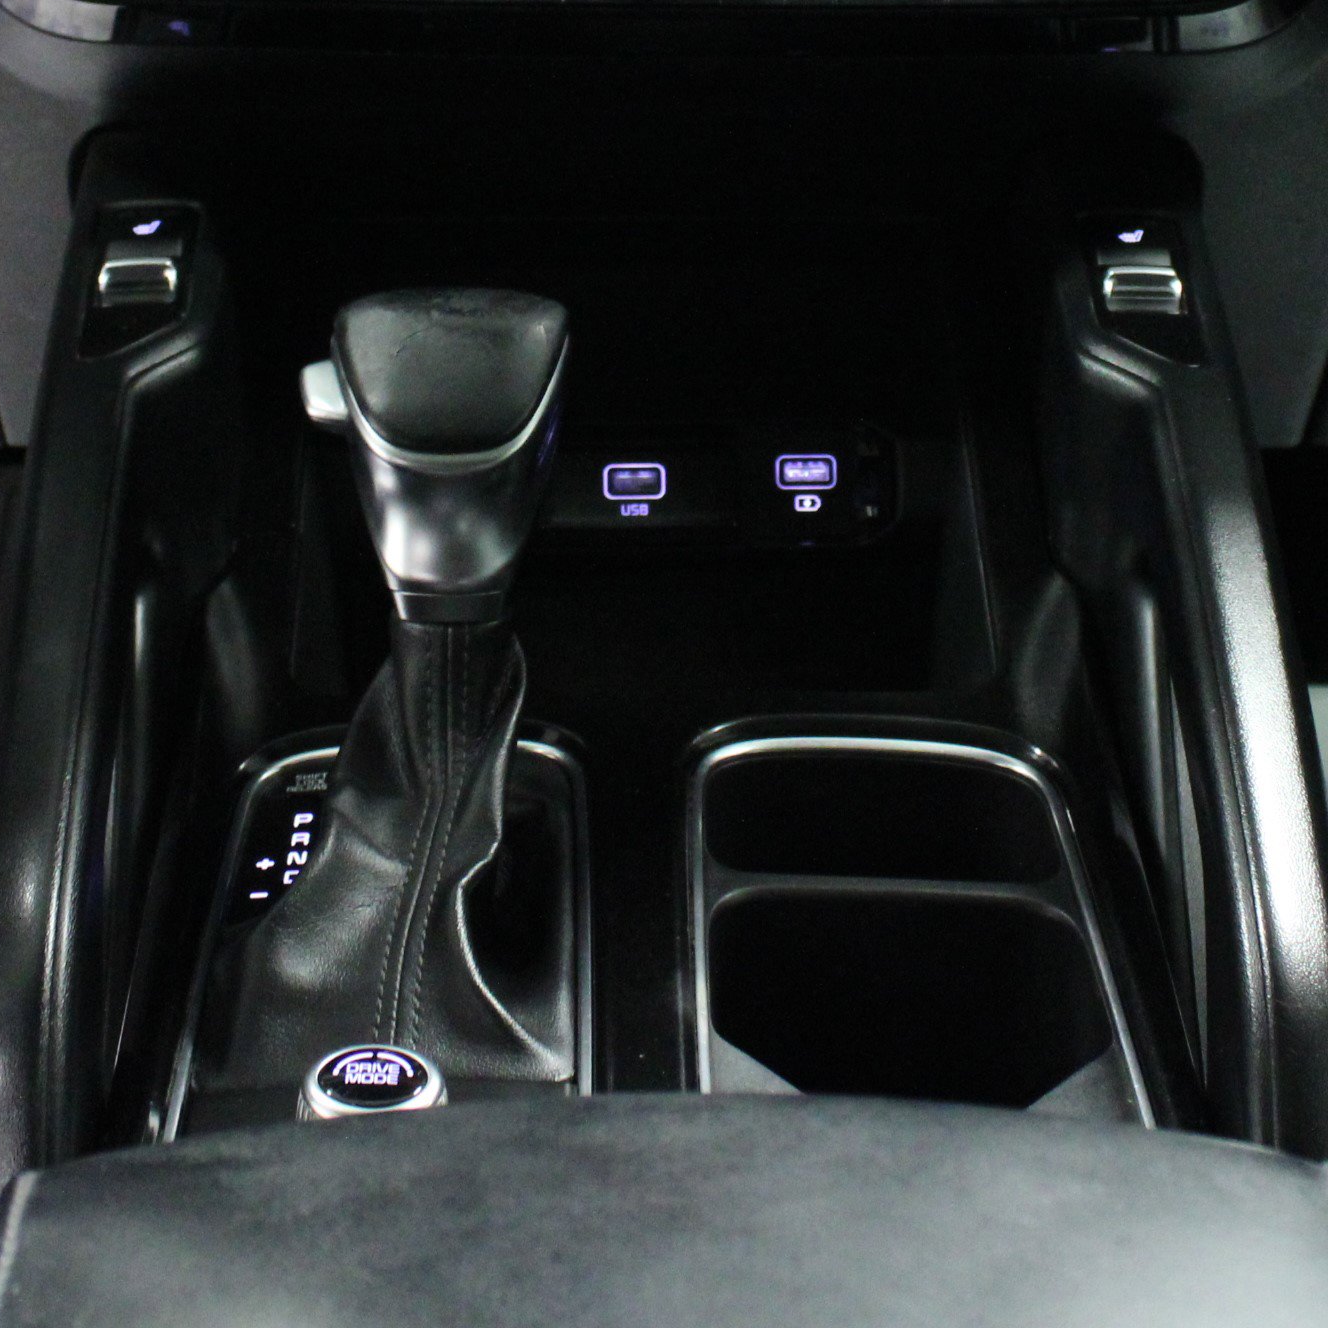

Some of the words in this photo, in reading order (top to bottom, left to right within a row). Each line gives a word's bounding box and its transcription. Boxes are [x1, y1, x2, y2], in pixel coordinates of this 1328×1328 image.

[621, 504, 649, 516] USB
[293, 813, 313, 828] P
[287, 851, 308, 865] N
[345, 1062, 400, 1073] DRIVE
[345, 1073, 399, 1085] MODE
